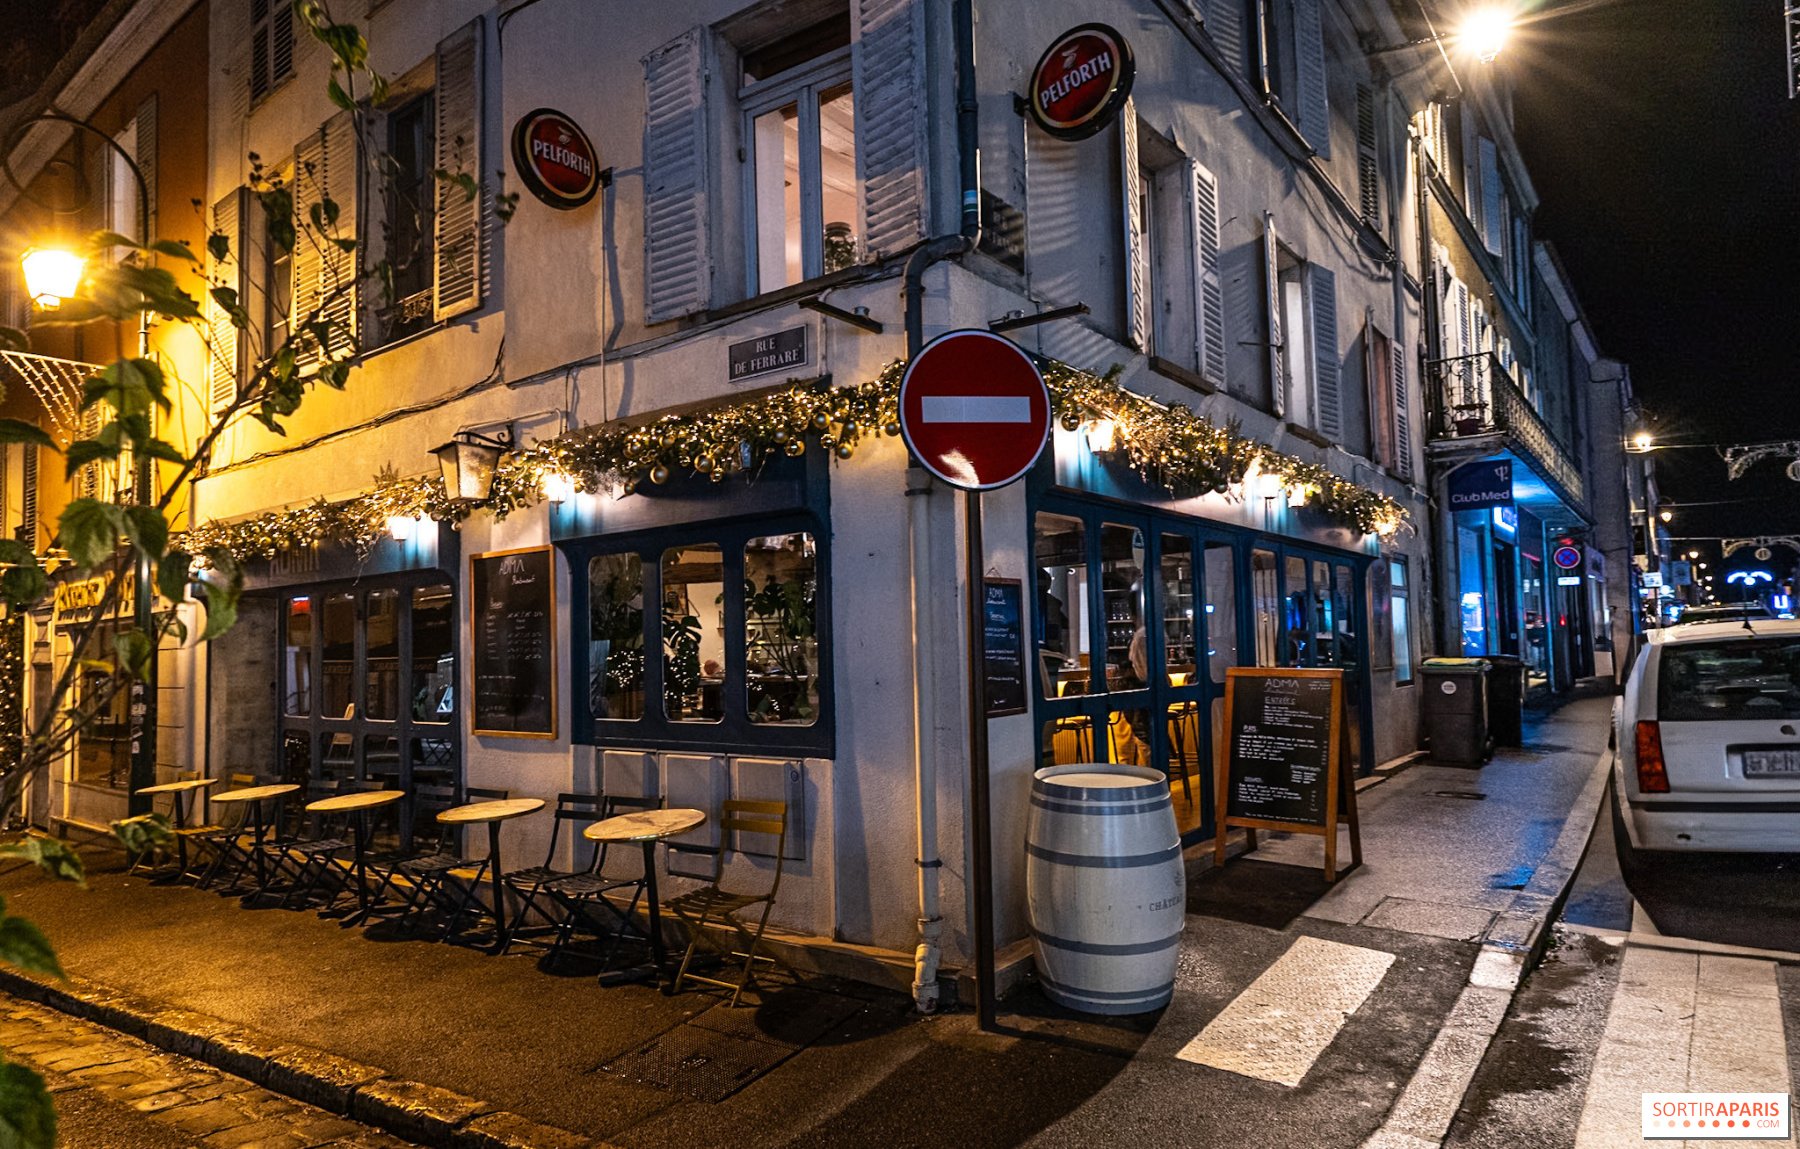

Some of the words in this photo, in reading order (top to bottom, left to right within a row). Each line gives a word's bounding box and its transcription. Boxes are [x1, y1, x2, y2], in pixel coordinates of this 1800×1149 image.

[1040, 51, 1112, 110] PELFORTH
[533, 138, 591, 177] PELFORTH
[756, 337, 776, 353] RUE
[734, 361, 747, 375] DE
[751, 348, 800, 371] FERRARE
[1452, 493, 1480, 503] Club
[1481, 490, 1510, 500] Med
[1264, 678, 1300, 688] ADMA
